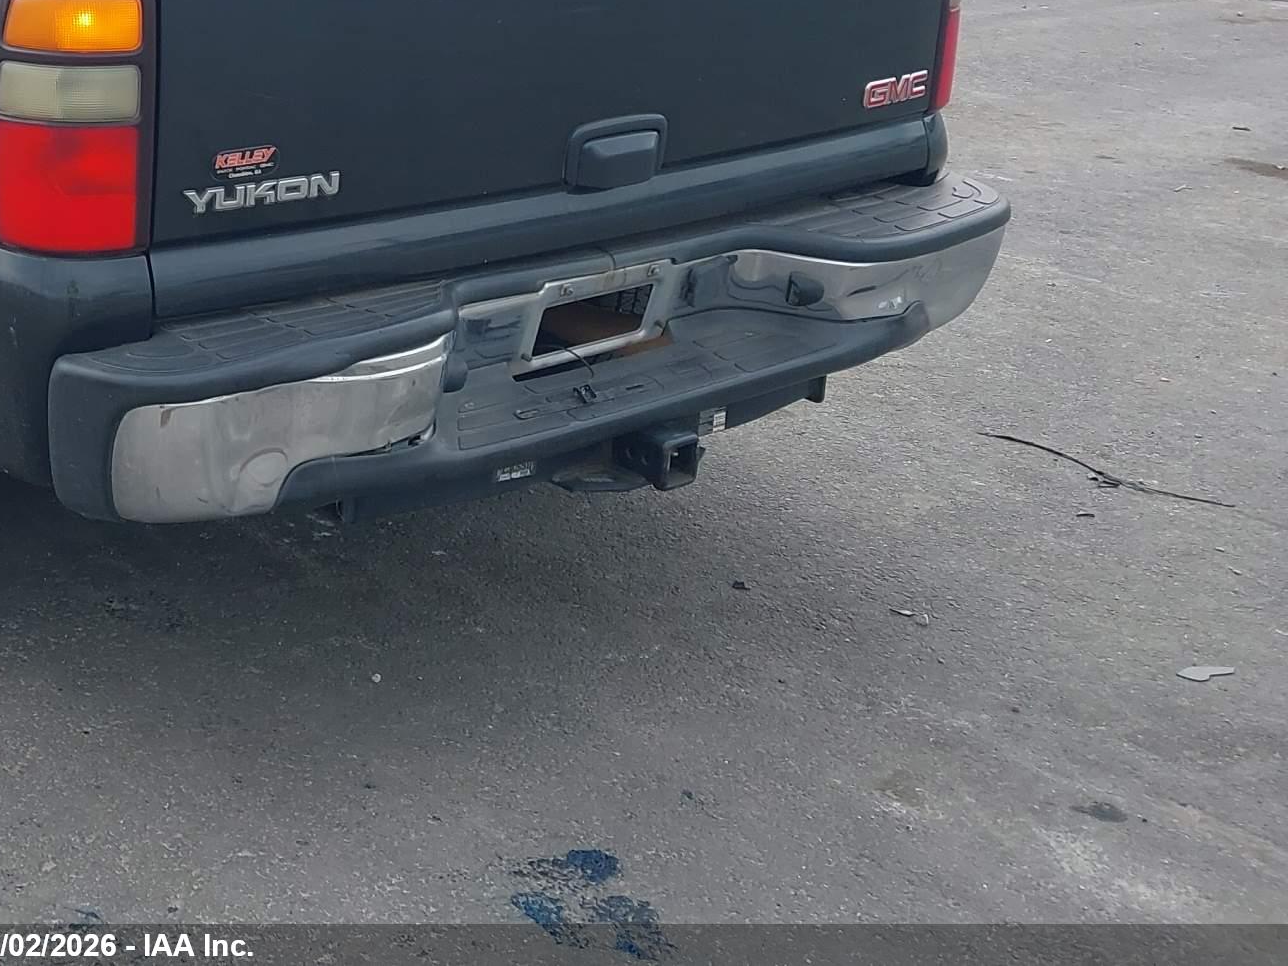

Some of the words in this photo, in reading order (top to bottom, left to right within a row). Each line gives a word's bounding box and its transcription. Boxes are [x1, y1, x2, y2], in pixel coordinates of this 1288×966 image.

[863, 69, 928, 109] GMC
[215, 147, 277, 169] KELLEY
[183, 171, 341, 214] YUKON
